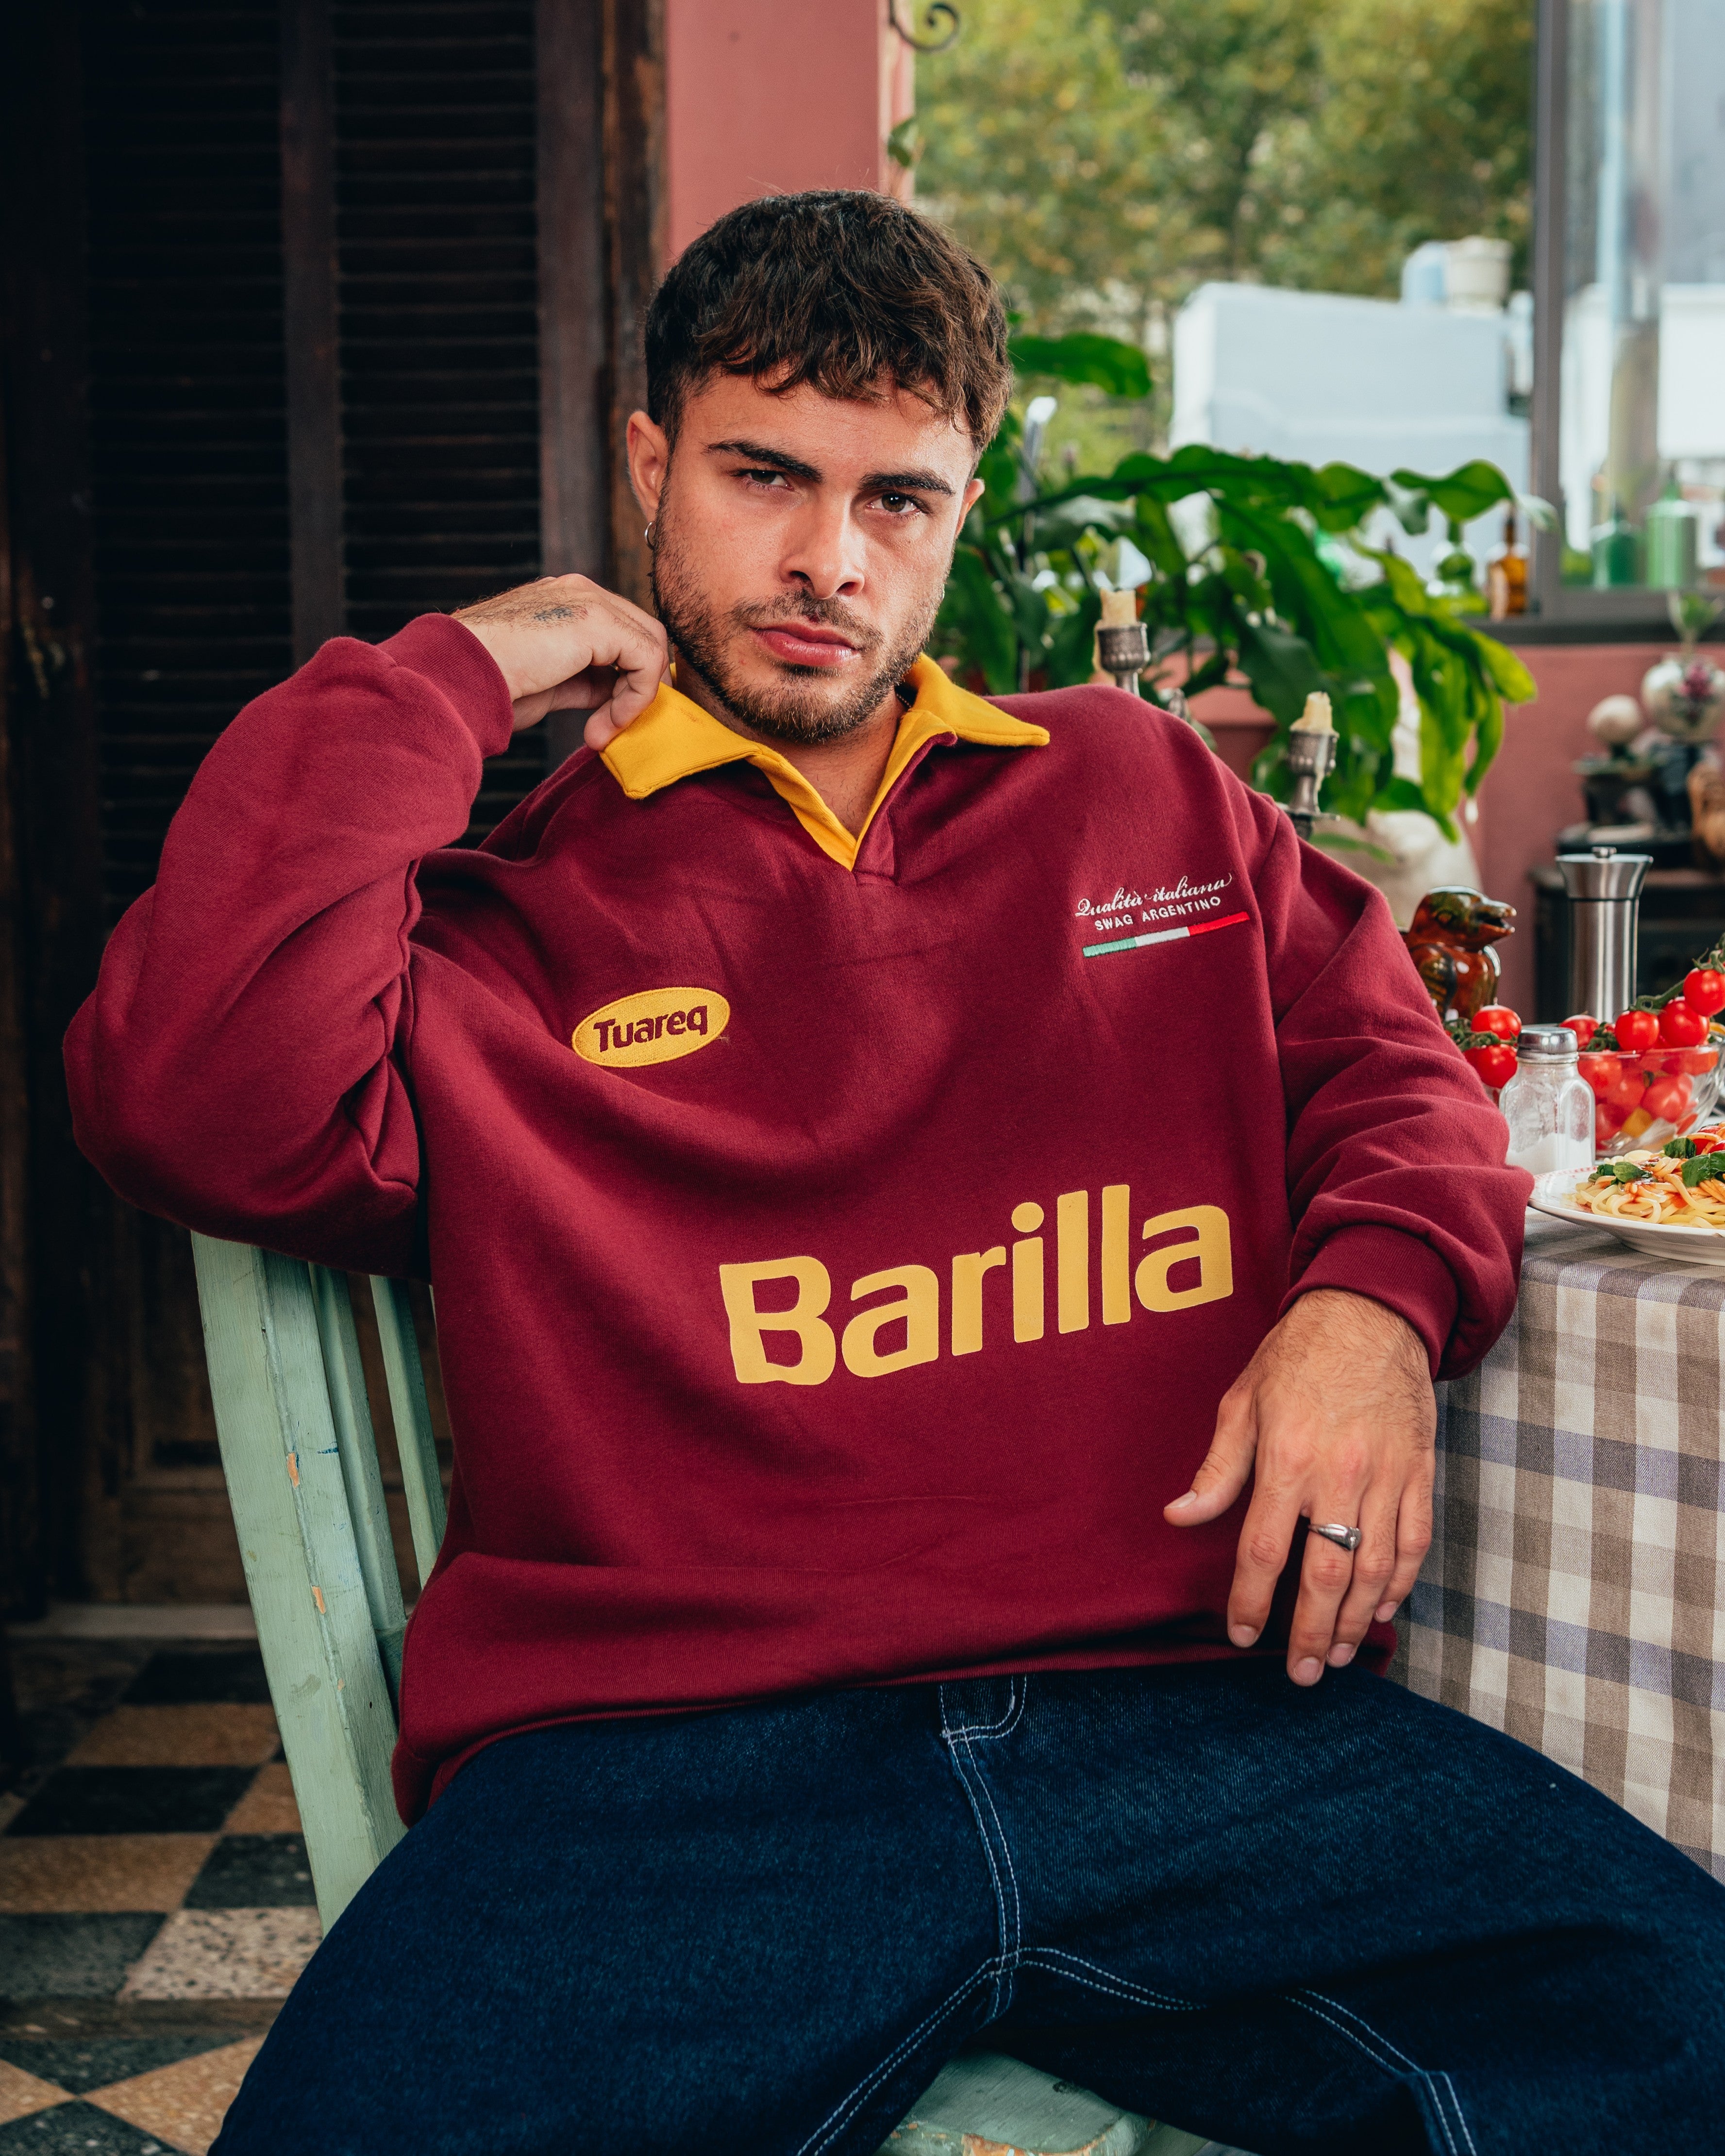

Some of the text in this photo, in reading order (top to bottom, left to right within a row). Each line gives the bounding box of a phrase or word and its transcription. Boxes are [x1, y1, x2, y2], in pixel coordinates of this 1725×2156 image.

[1075, 873, 1233, 917] Qualità italiana
[1094, 896, 1221, 931] SWAG ARGENTINO
[719, 1184, 1234, 1385] Barilla
